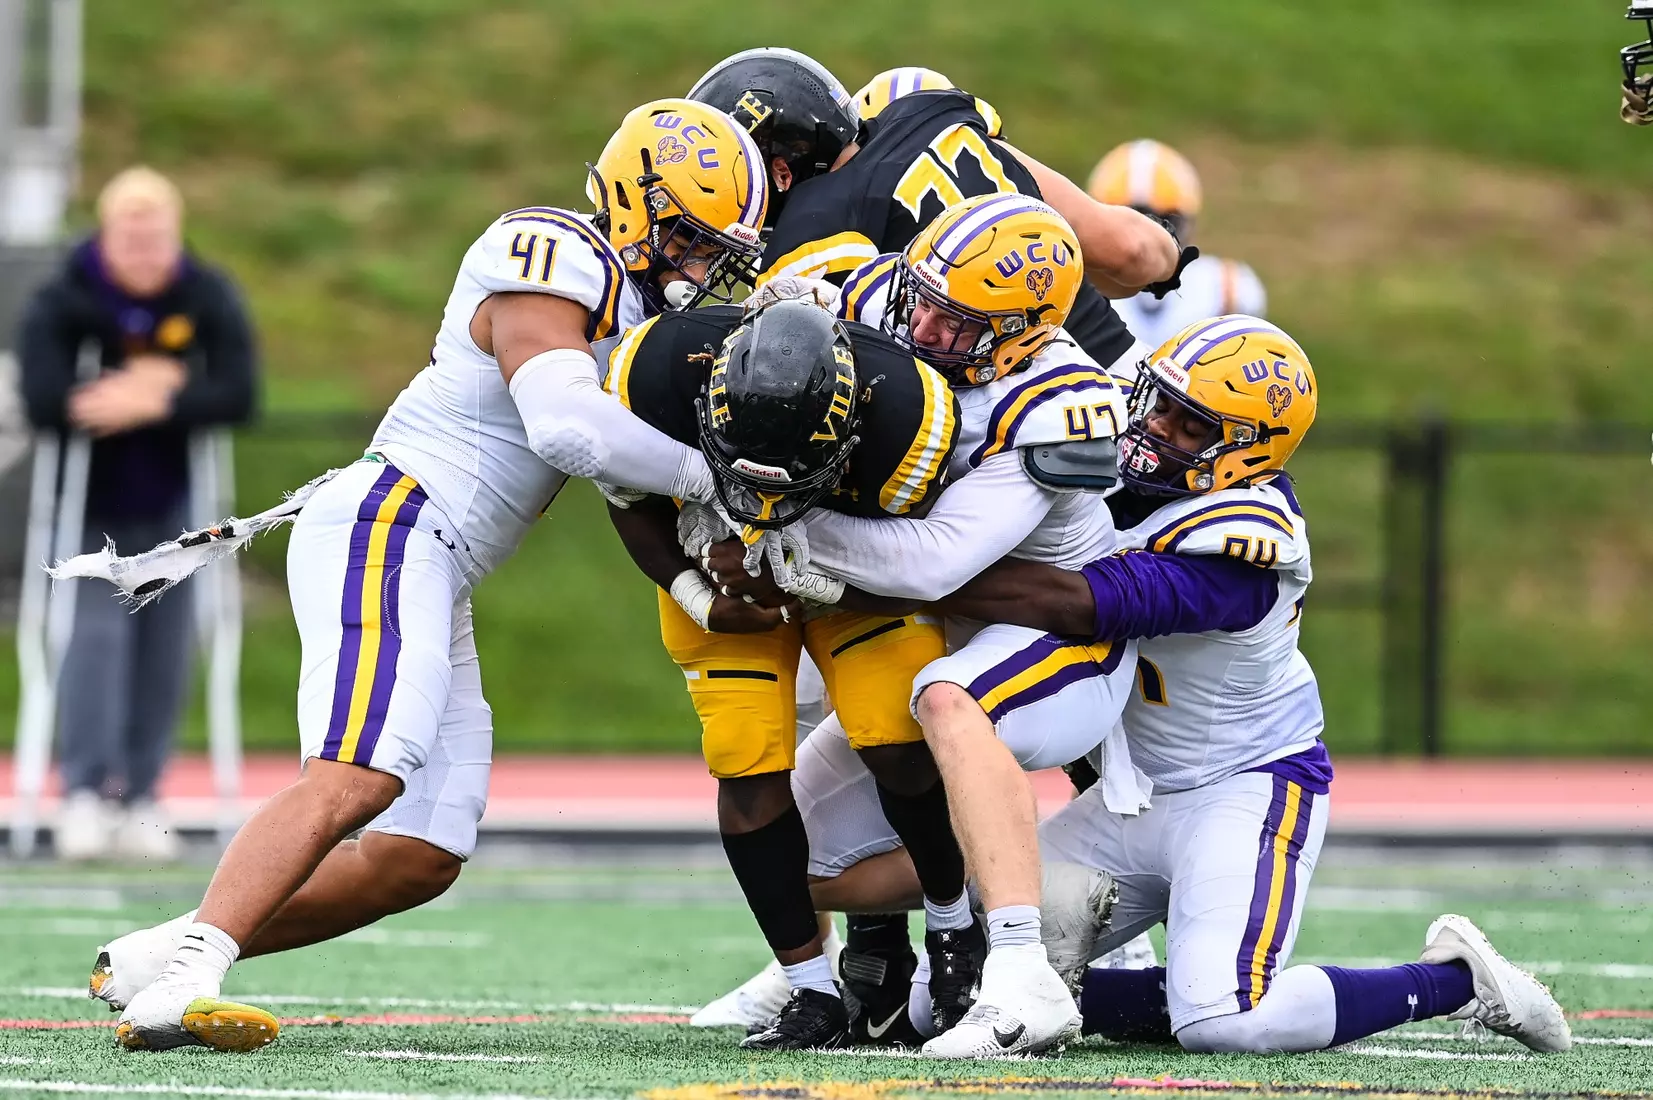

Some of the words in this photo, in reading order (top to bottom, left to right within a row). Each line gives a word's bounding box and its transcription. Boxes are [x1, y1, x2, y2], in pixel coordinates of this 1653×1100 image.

[653, 114, 720, 169] WCU
[893, 122, 1019, 224] 77
[508, 231, 561, 286] 41
[915, 263, 943, 290] Riddell
[994, 242, 1067, 279] WCU
[809, 344, 855, 441] VILLE
[1241, 359, 1308, 396] WCU
[1063, 401, 1120, 441] 47
[740, 464, 781, 478] Riddell
